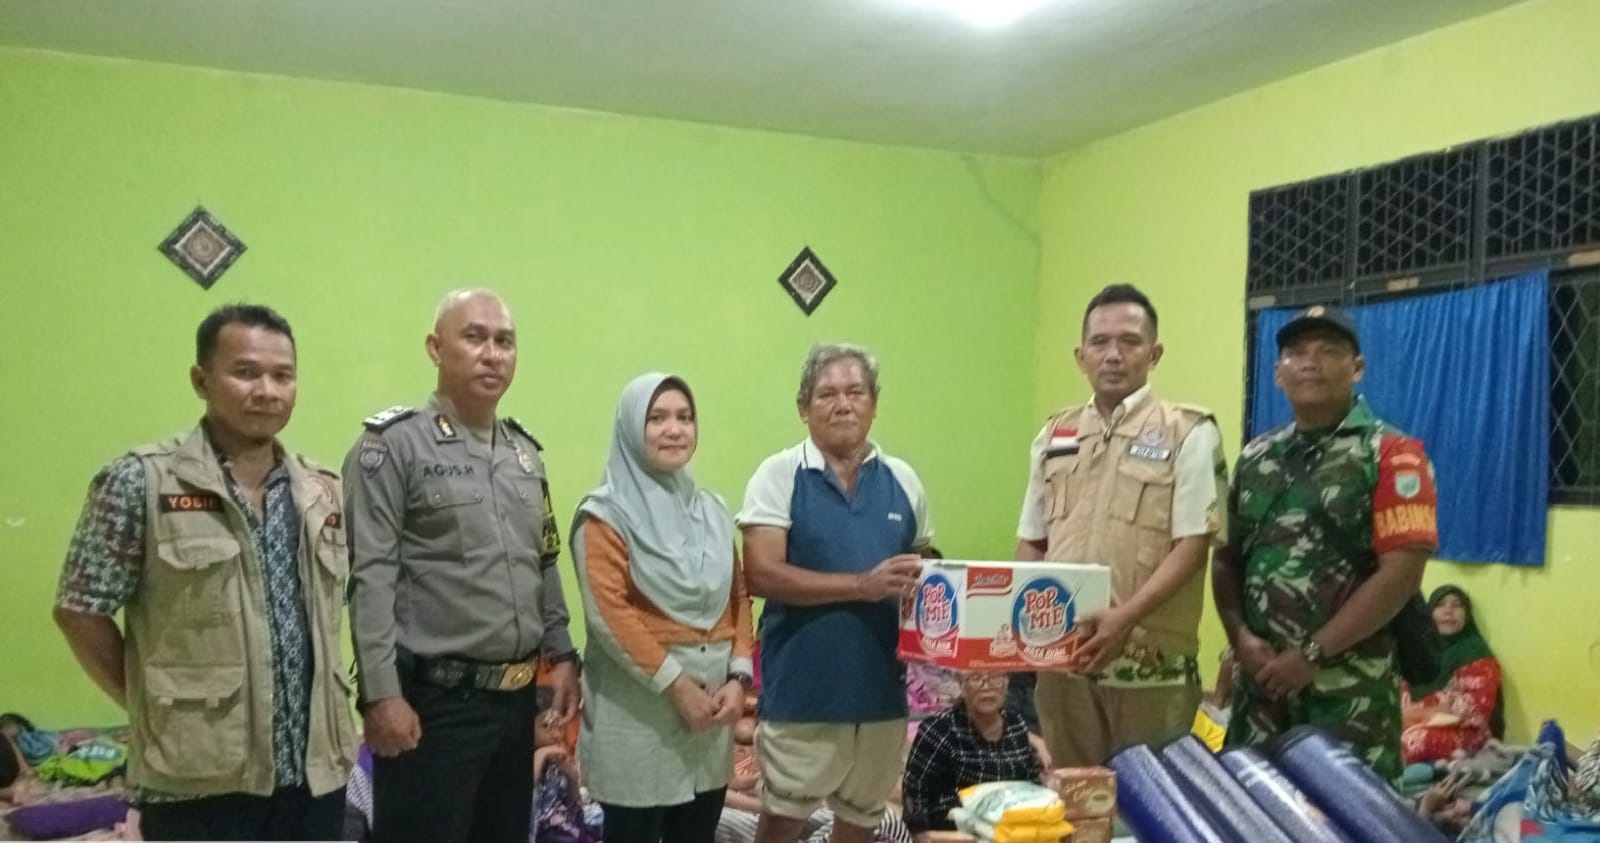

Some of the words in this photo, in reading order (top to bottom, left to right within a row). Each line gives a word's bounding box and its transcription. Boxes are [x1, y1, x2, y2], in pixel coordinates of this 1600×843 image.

[924, 585, 945, 606] POP
[1024, 588, 1058, 613] POP
[926, 602, 951, 622] MIE
[1030, 603, 1064, 629] MIE
